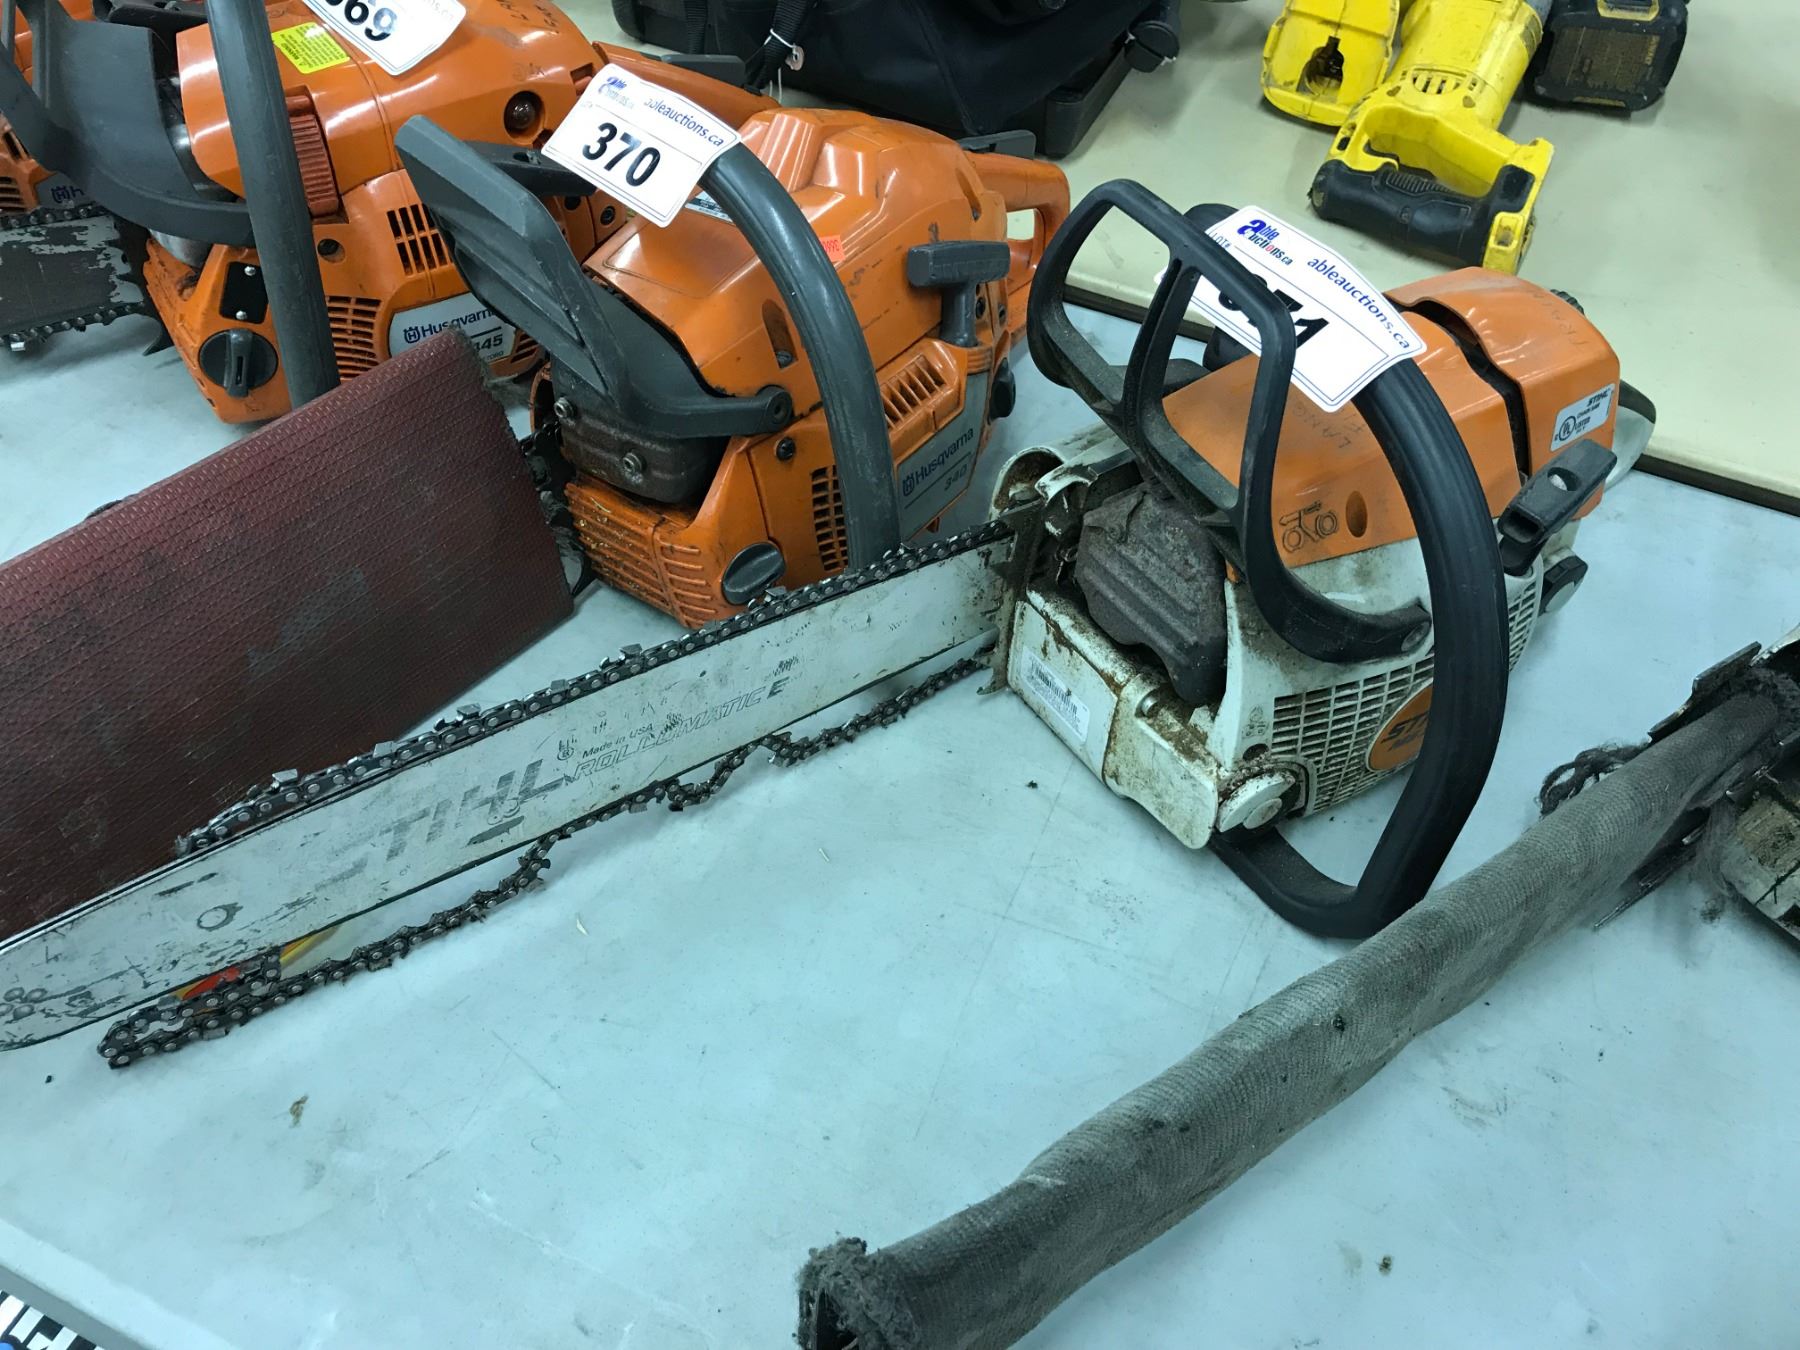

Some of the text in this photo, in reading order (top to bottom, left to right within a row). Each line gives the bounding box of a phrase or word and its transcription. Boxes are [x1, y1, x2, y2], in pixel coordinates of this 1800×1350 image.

[324, 0, 398, 42] 69
[582, 122, 661, 187] 370
[1306, 257, 1411, 350] ableauctions.ca
[915, 427, 974, 485] Husqvarna
[582, 741, 613, 759] Made
[629, 722, 654, 739] USA
